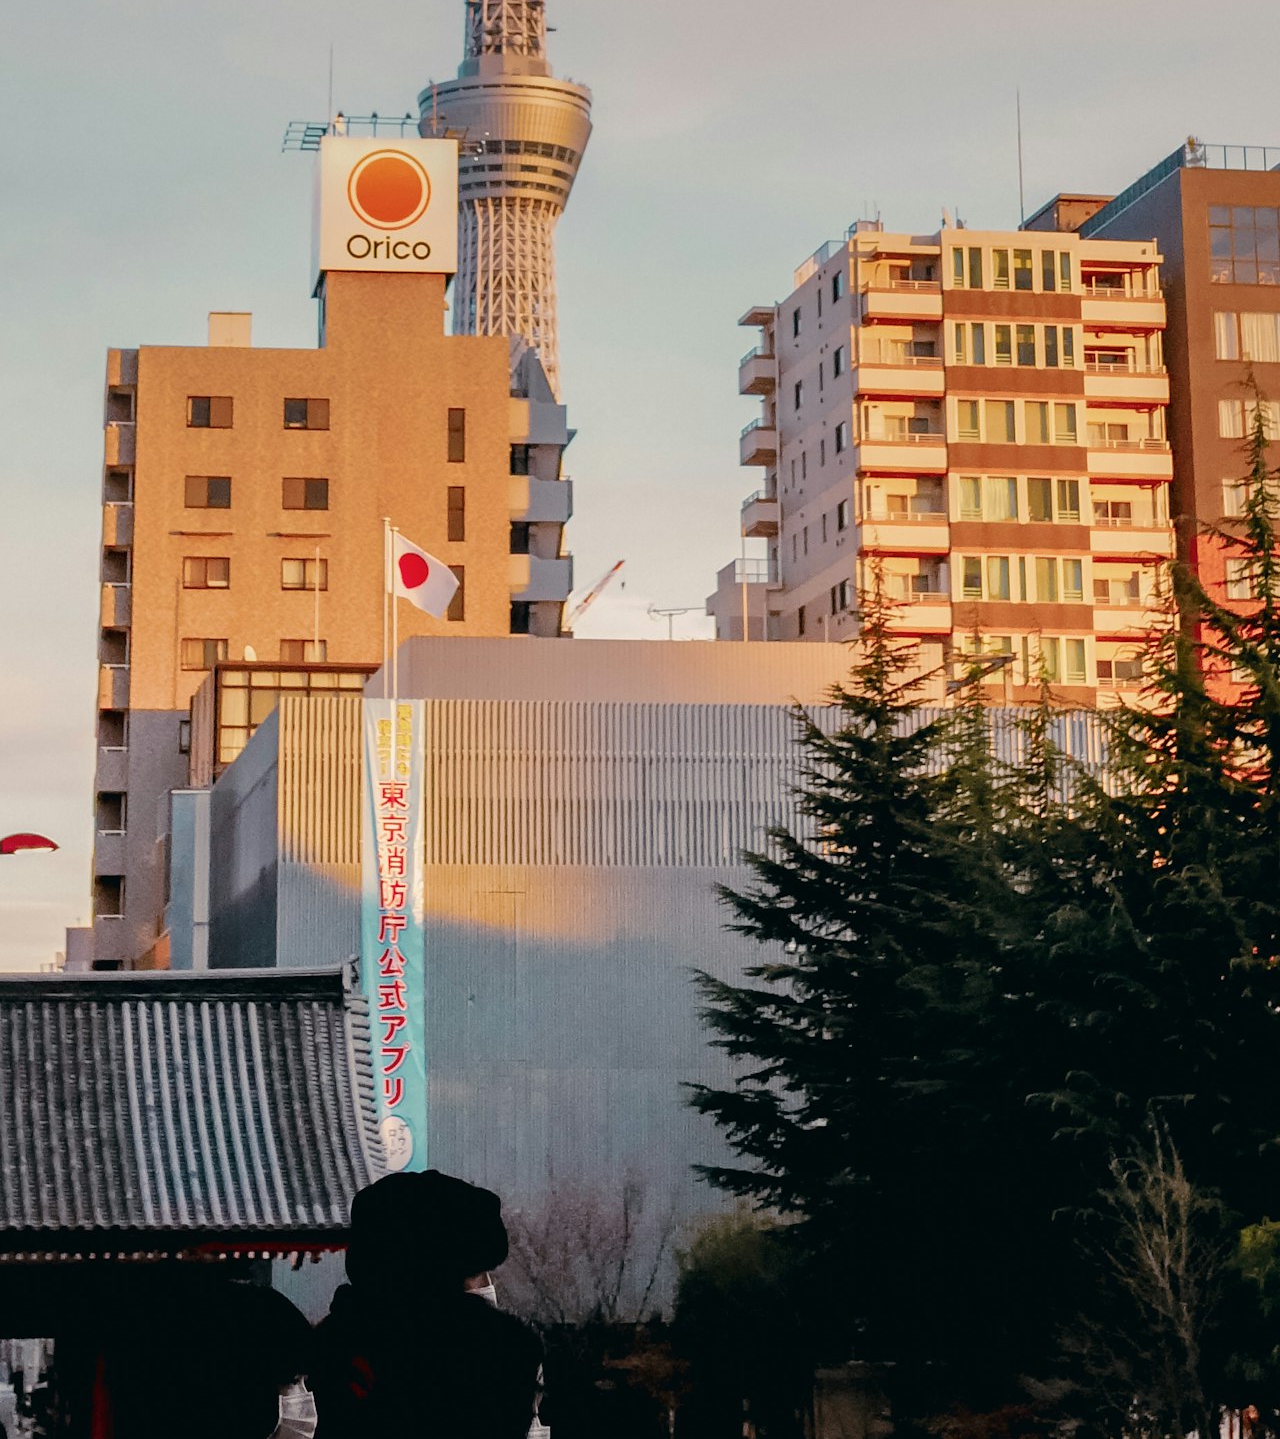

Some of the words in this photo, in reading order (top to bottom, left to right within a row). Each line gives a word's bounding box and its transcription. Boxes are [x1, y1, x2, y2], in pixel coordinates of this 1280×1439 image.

[346, 233, 431, 261] Orico
[378, 779, 410, 1110] 東京消防庁公式アプリ
